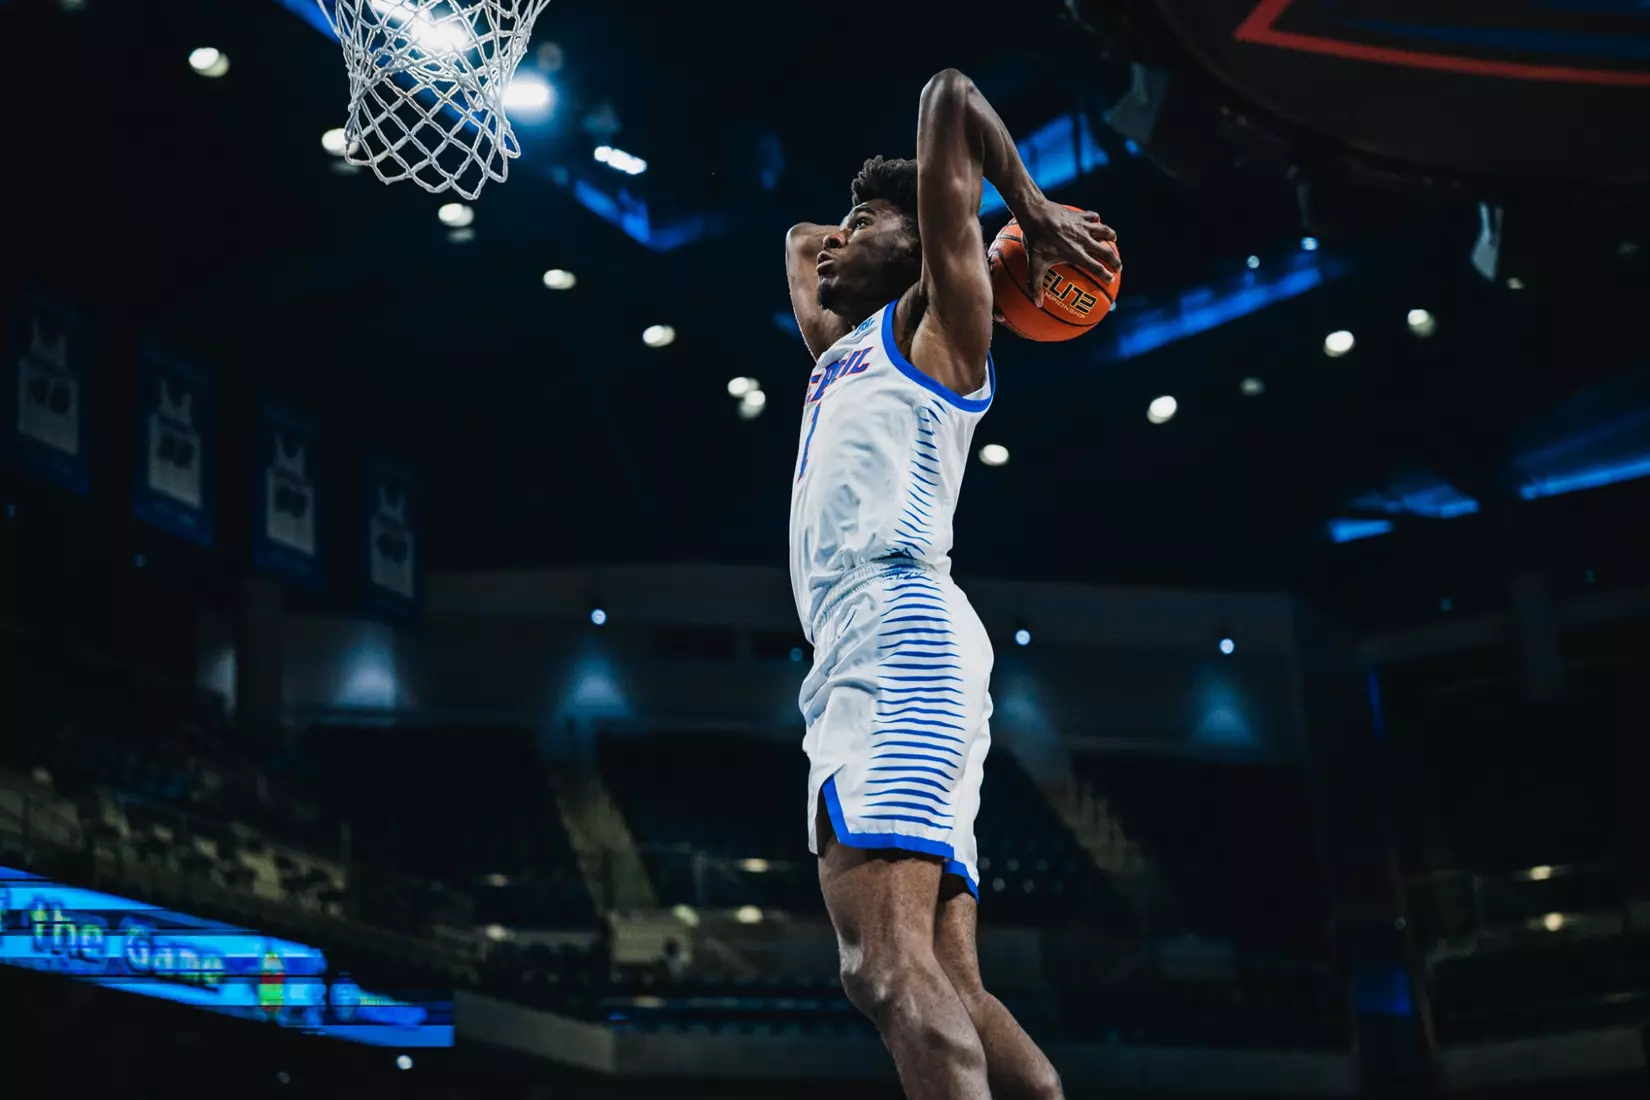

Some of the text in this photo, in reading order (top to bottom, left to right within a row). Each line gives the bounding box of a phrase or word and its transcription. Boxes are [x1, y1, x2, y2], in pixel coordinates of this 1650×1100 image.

[1043, 268, 1098, 315] ELITE
[1045, 291, 1086, 319] MPIONSHIP
[30, 899, 104, 957] the
